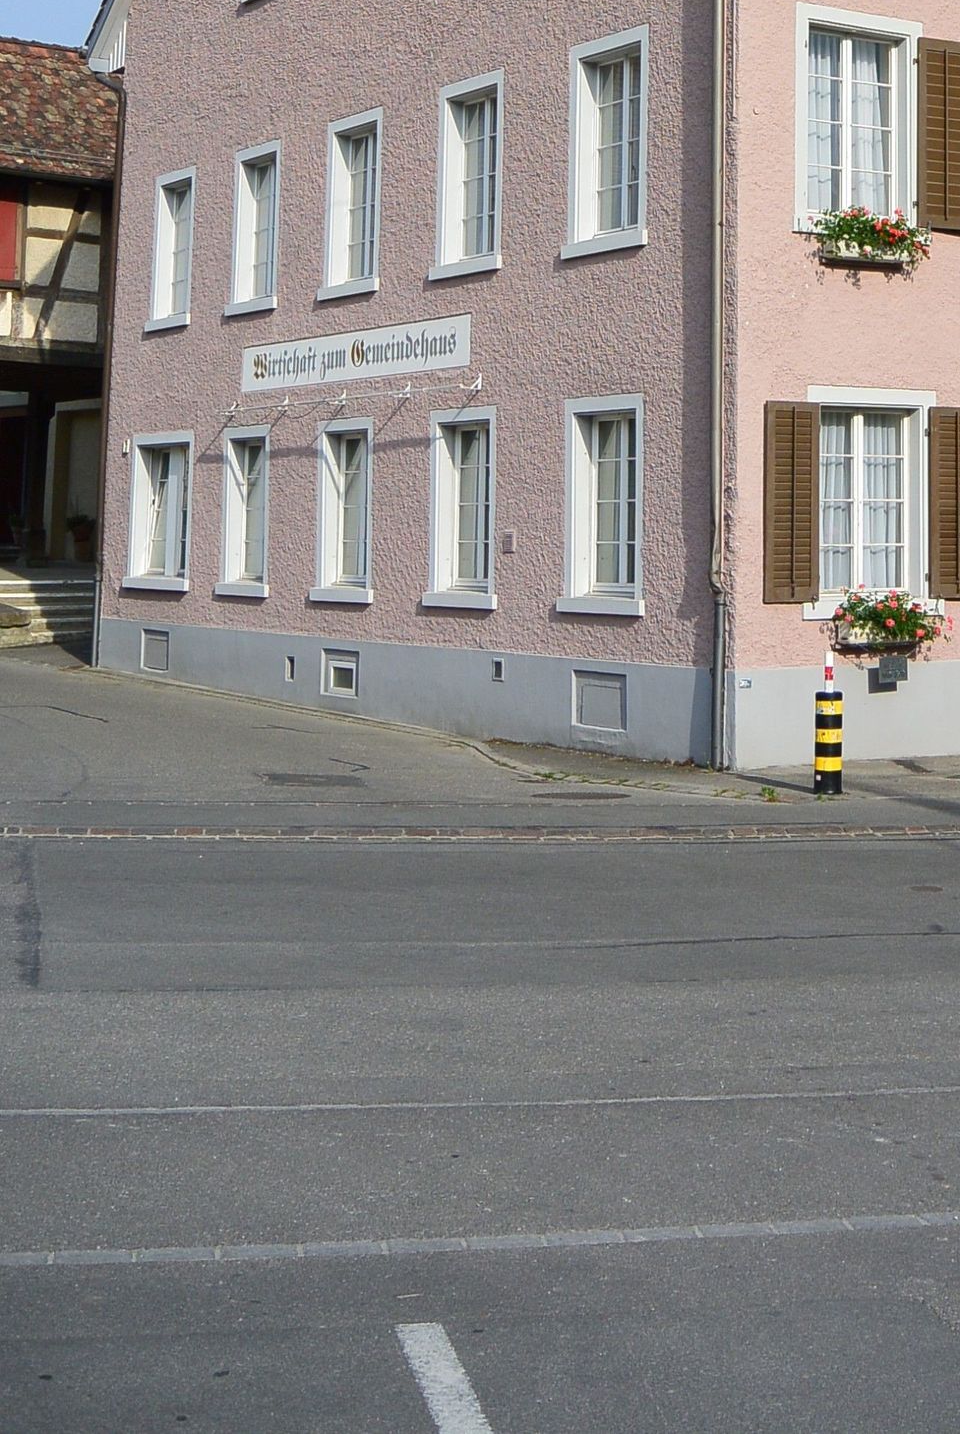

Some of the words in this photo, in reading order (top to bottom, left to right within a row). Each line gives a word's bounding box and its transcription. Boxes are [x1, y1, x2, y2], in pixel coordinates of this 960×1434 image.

[253, 346, 317, 383] Wirtschaft
[320, 348, 347, 381] zum
[351, 326, 457, 368] Gemeindehaus
